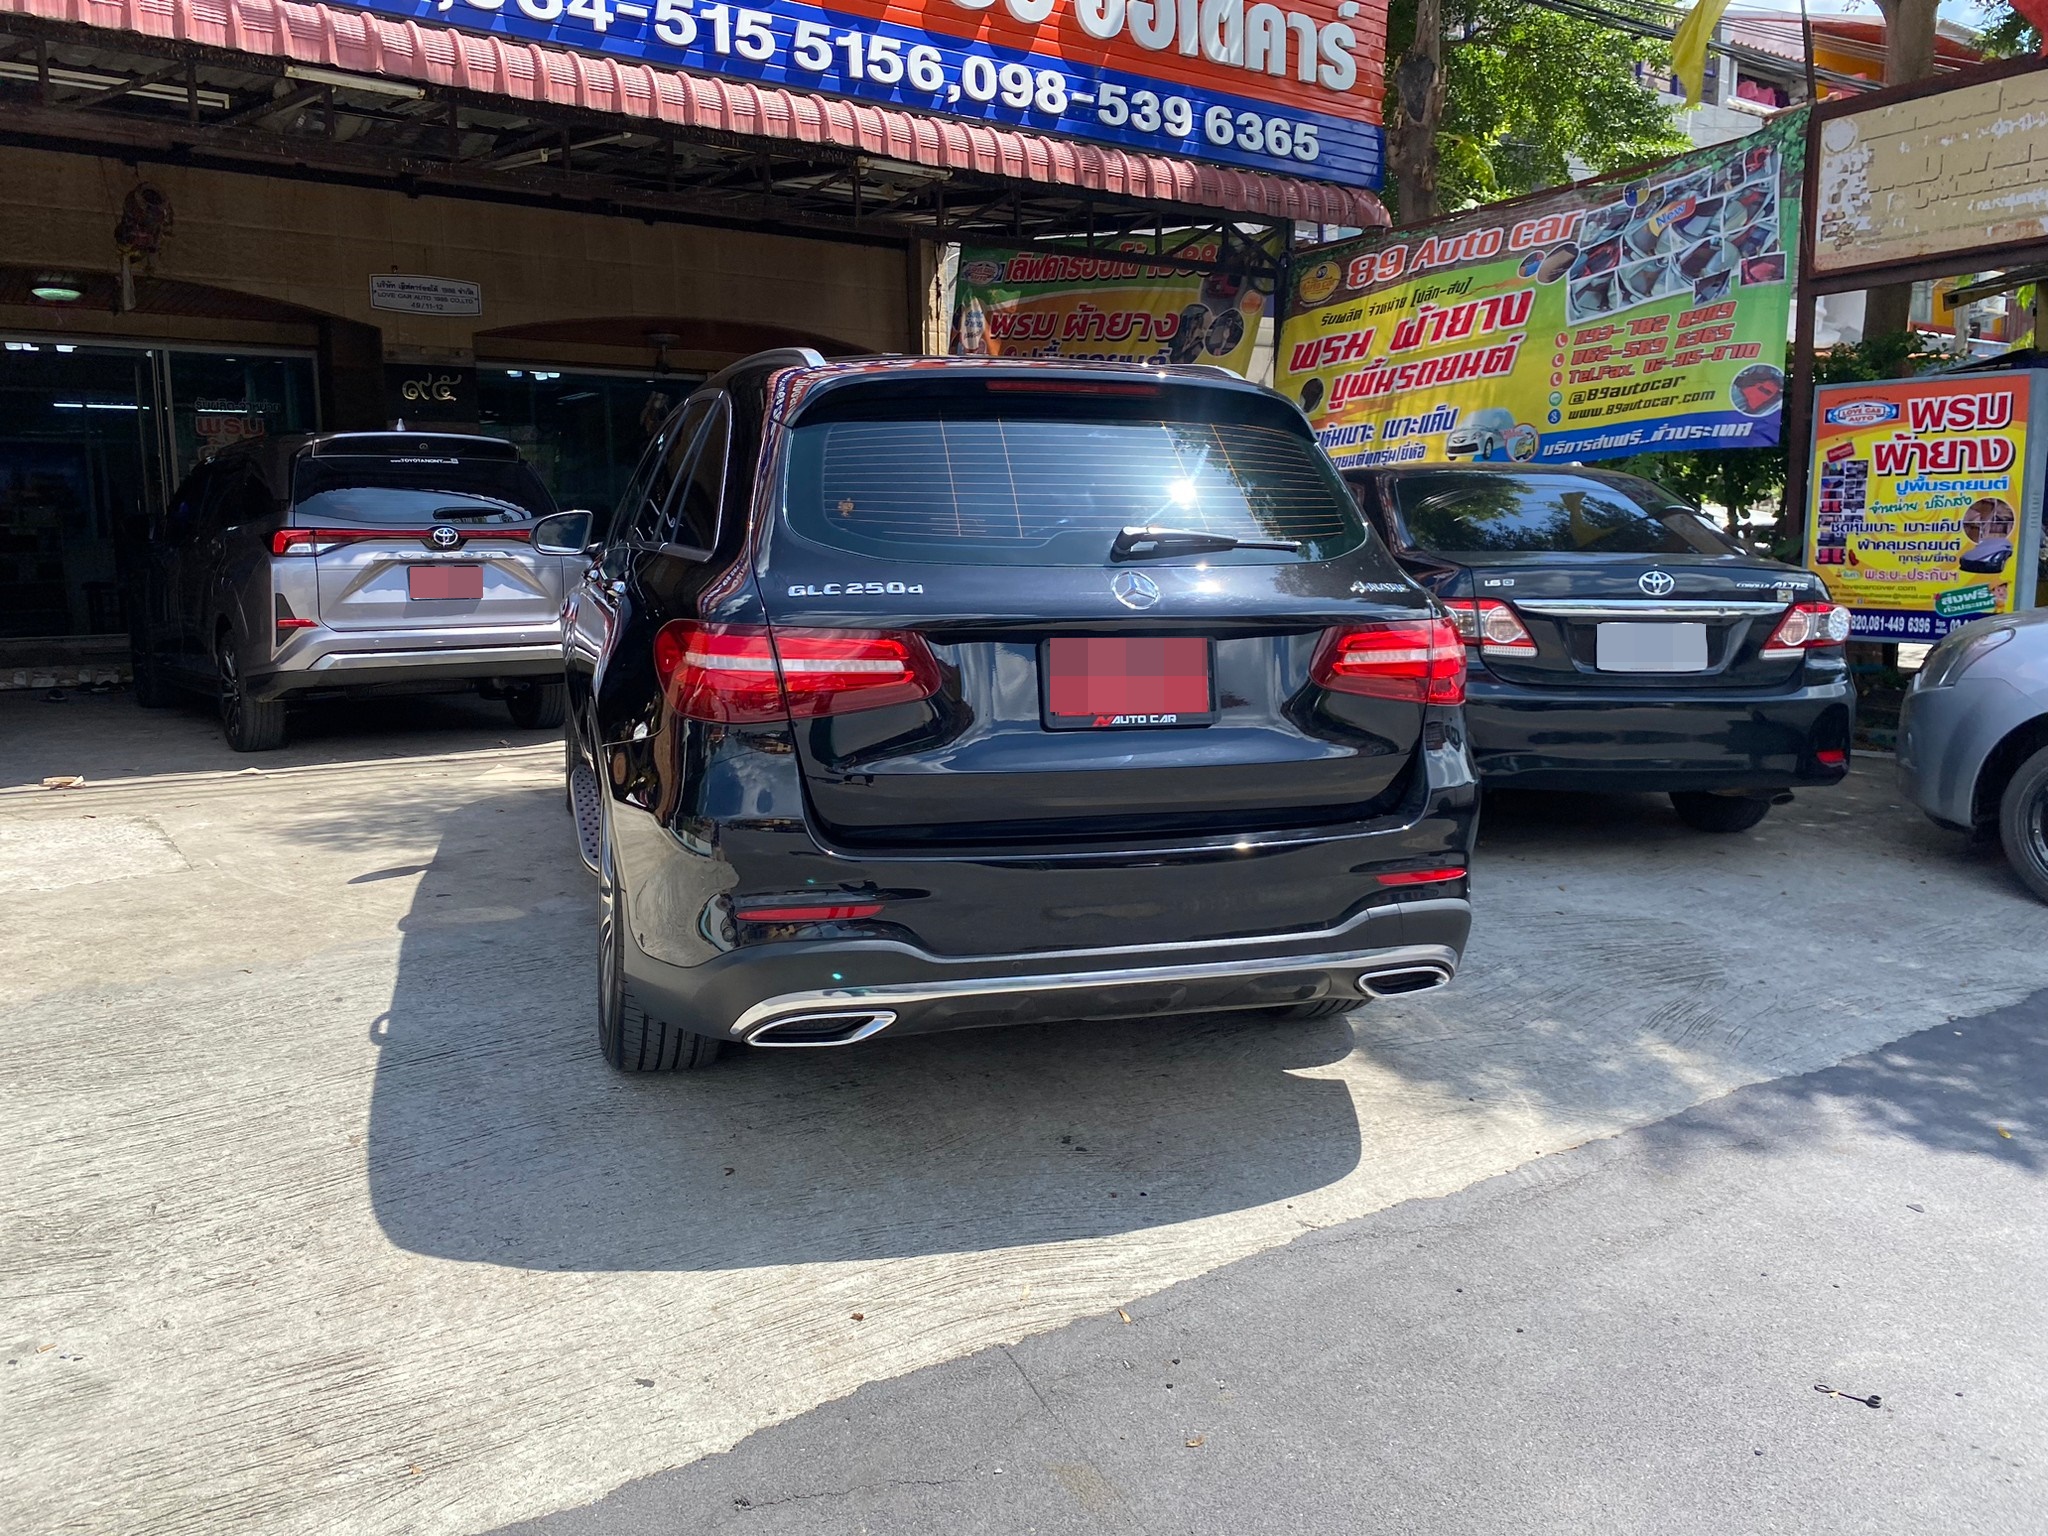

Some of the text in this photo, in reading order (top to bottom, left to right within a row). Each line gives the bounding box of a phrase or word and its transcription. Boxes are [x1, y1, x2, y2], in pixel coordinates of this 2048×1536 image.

[1204, 104, 1320, 162] 6365
[1656, 203, 1686, 228] New
[1347, 208, 1588, 290] 89 Auto car
[1368, 295, 1408, 317] จำหน่าย
[989, 310, 1057, 341] พรม
[1063, 303, 1181, 342] ผ้ายาง
[1288, 286, 1537, 375] พรม ผ้ายาง
[1673, 322, 1737, 350] 6365
[1327, 331, 1527, 412] ปูพื้นรถยนต์
[1568, 375, 1687, 406] @89autocar
[1568, 389, 1717, 421] www.89autocar.com
[1842, 408, 1863, 417] LOVE
[1908, 392, 2013, 434] พรม
[194, 414, 265, 437] พรม
[1872, 433, 2012, 477] ผ้ายาง
[1895, 475, 2009, 496] ปูพื้นรถยนต์
[1869, 496, 1973, 515] จำหน่าย ปลีกส่ง
[1830, 520, 1896, 537] ชุดหุ้มเบาะ
[1857, 537, 1961, 555] ผ้าคลุมรถยนต์
[787, 581, 925, 598] GLC 250d
[1771, 581, 1809, 591] ALTIS
[1907, 616, 1931, 633] 6396
[1111, 714, 1147, 725] AUTO
[1149, 714, 1178, 724] CAR
